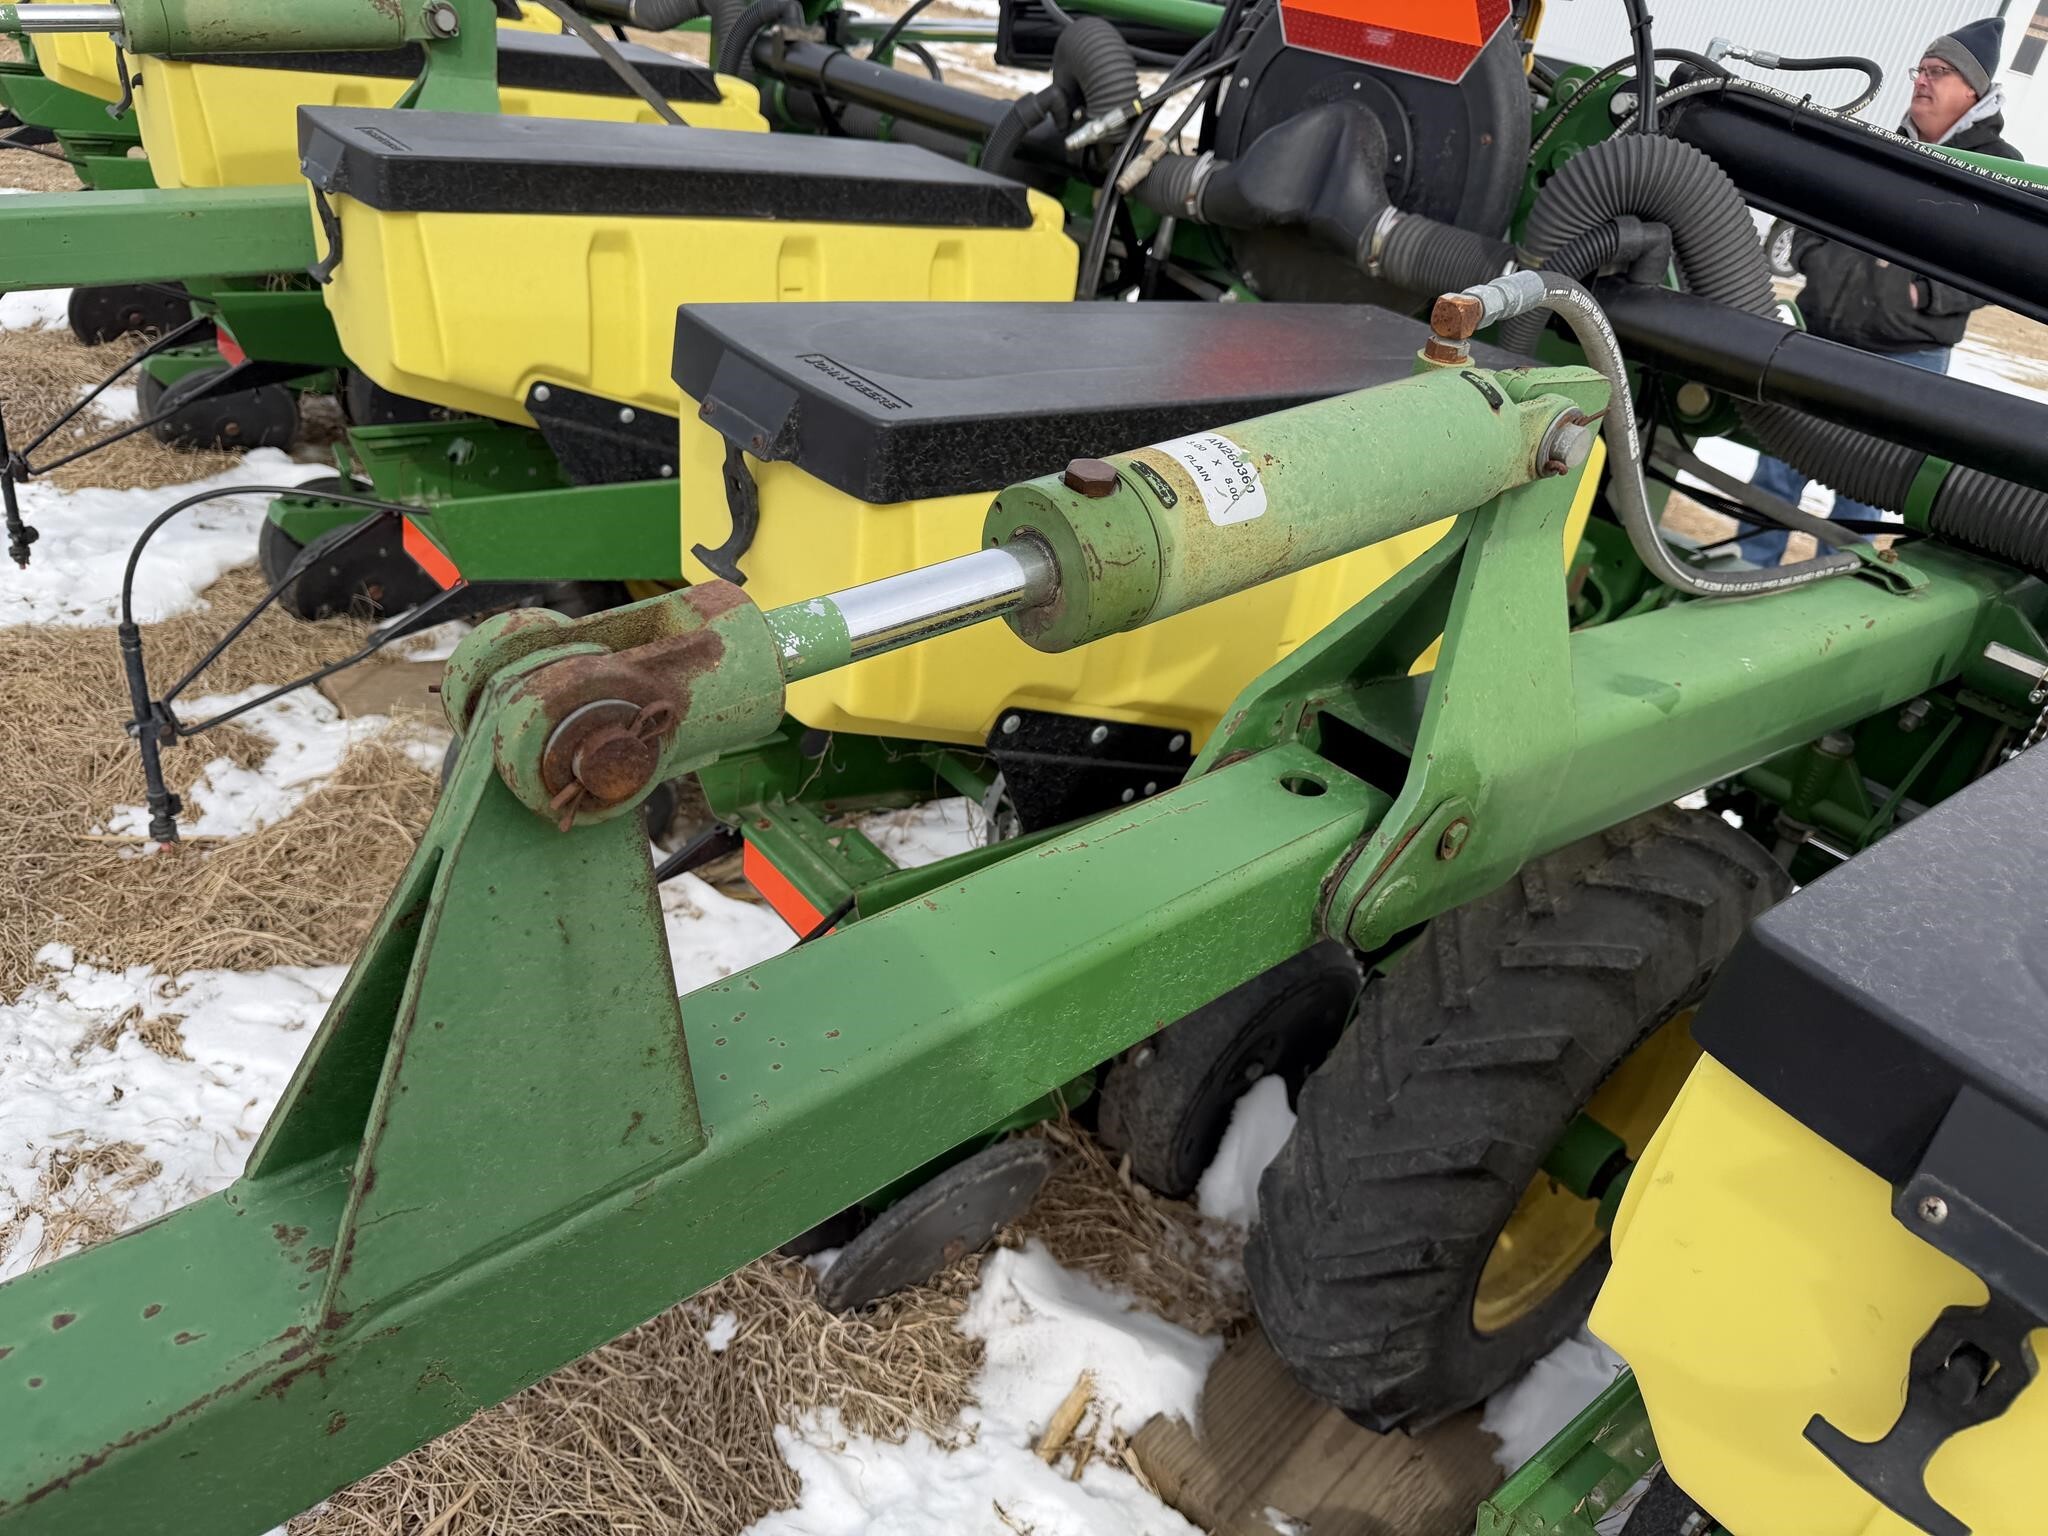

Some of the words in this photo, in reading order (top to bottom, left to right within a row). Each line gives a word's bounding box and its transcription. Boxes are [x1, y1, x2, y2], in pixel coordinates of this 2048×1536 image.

[1931, 150, 1947, 161] mm
[1947, 156, 1967, 170] (1/4)
[1966, 163, 1974, 172] X
[1974, 166, 1989, 177] 1W
[1184, 454, 1212, 482] PLAIN
[1186, 440, 1207, 452] 3.00
[1224, 477, 1240, 501] 8.00
[1205, 438, 1256, 494] AN260360
